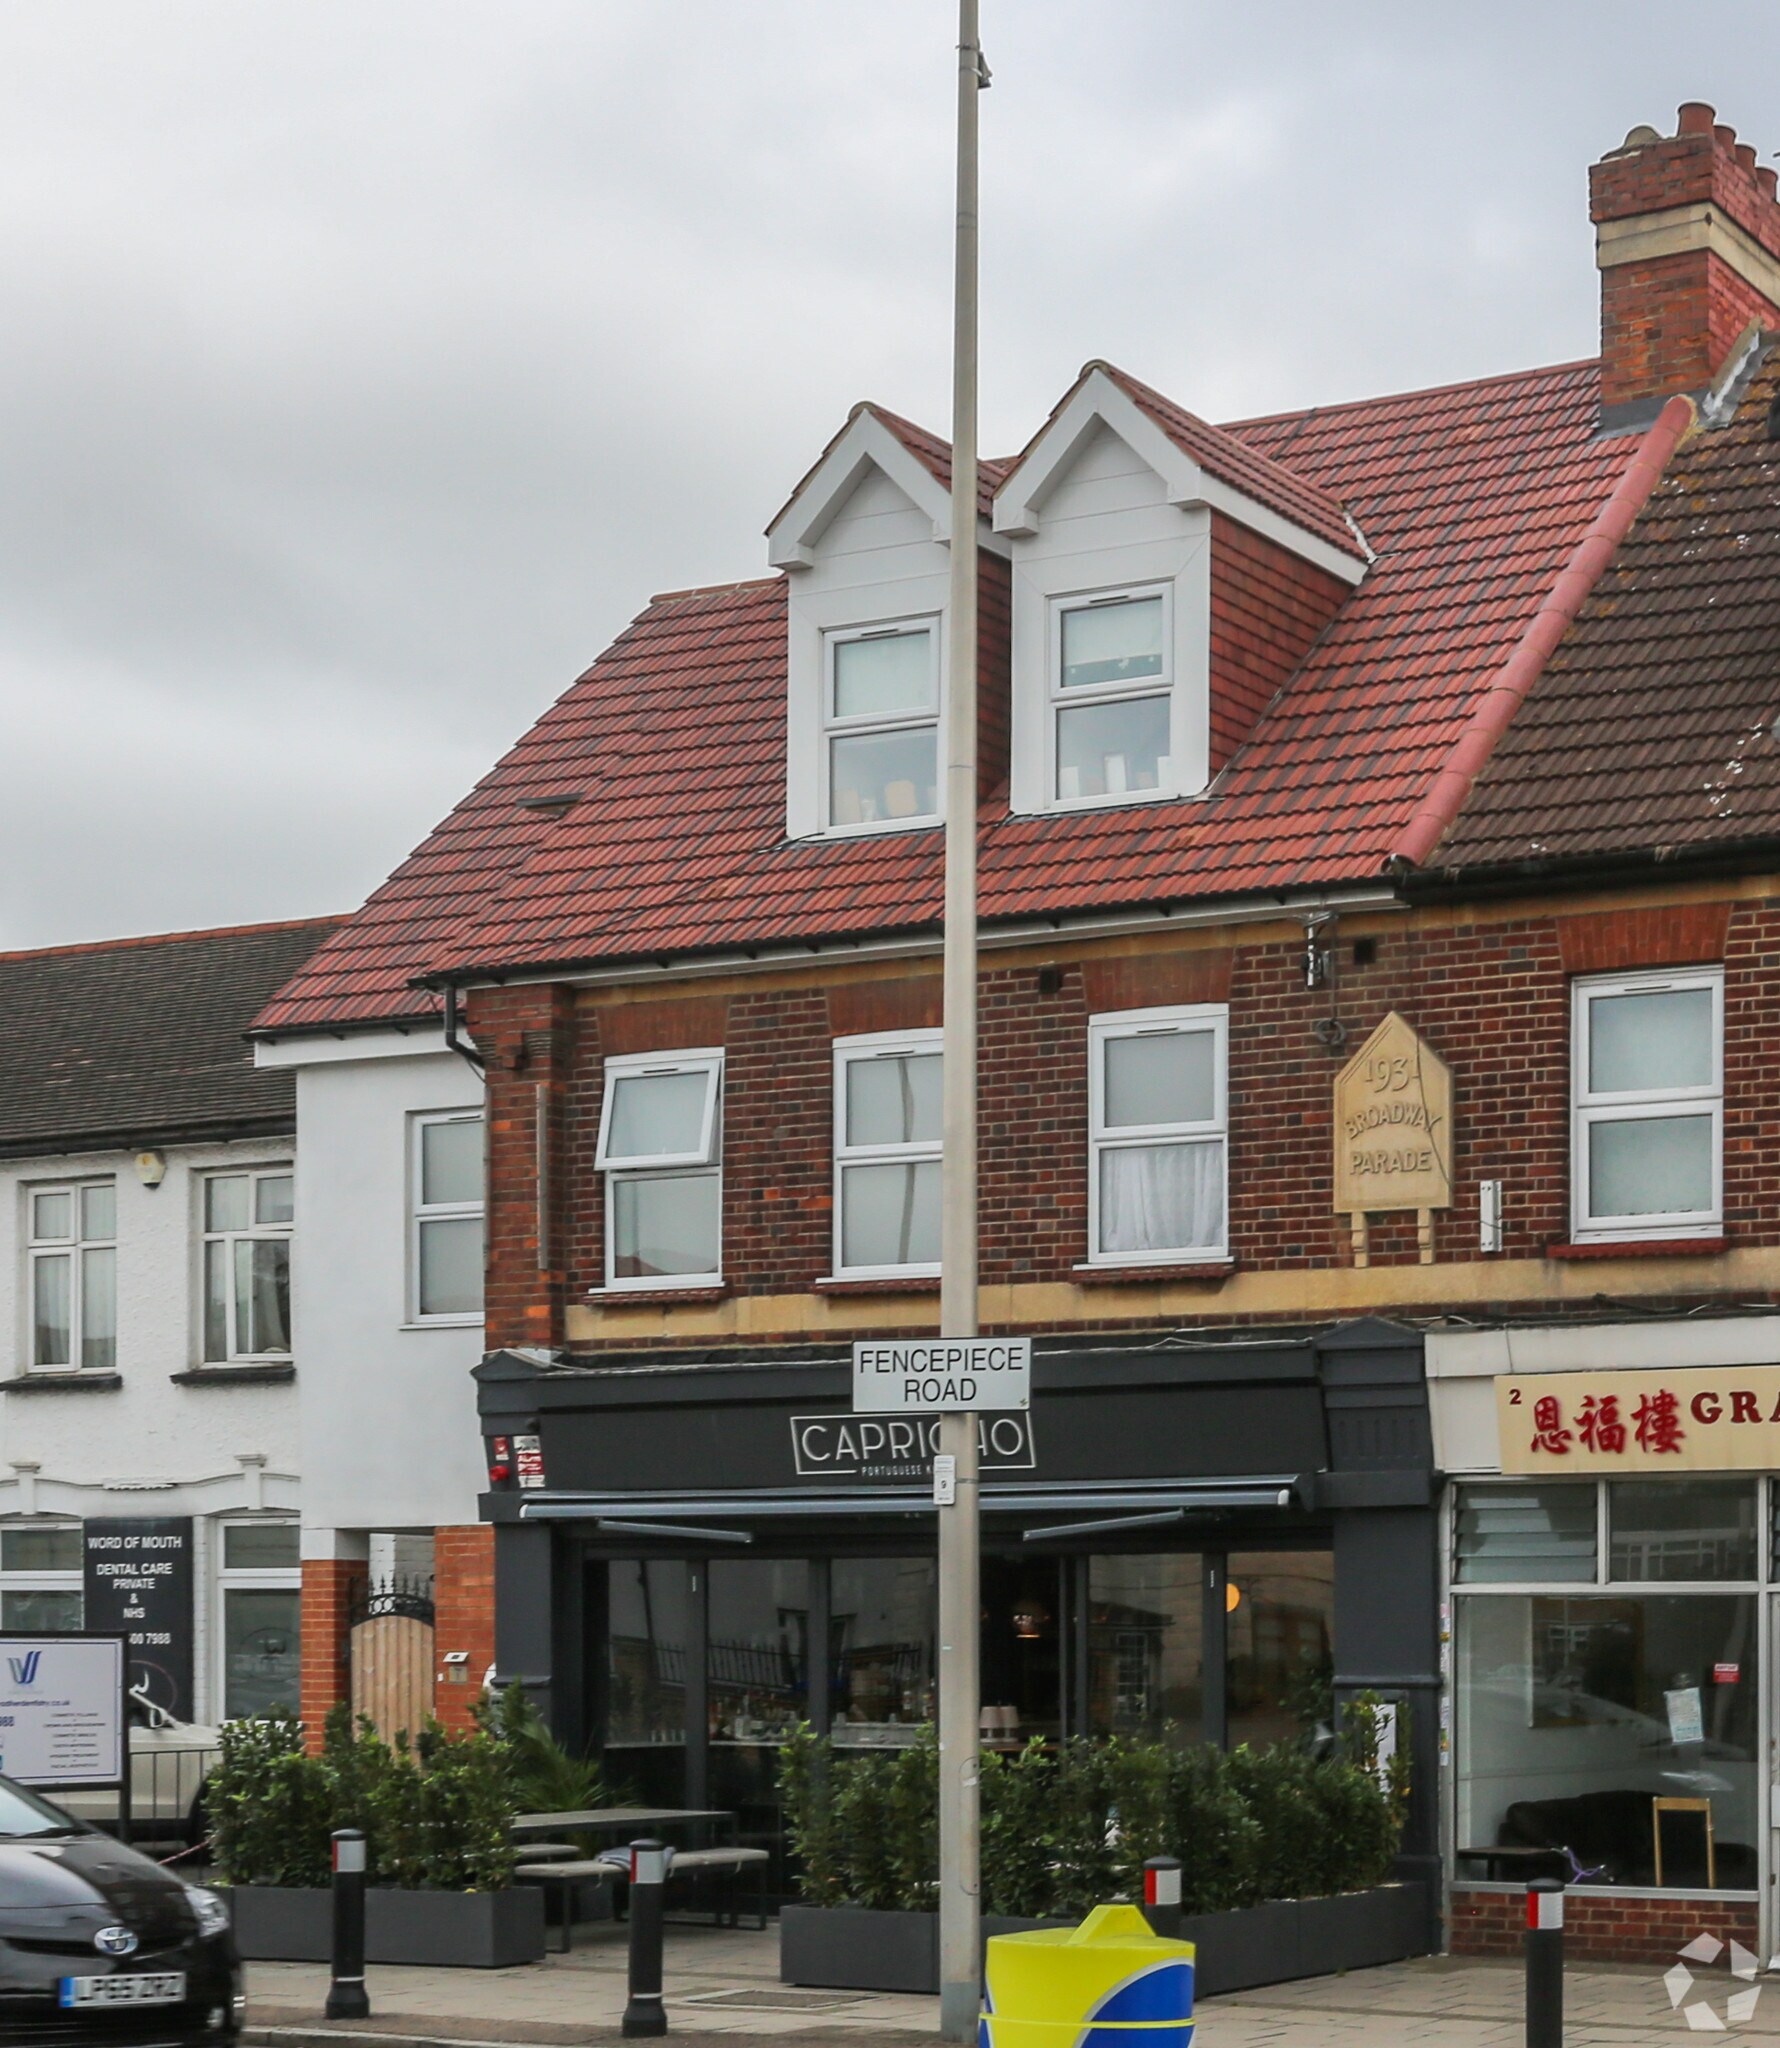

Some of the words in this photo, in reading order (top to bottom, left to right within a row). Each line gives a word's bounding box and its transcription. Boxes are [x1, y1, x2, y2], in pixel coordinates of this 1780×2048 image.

[1345, 1101, 1442, 1140] BROADWAY
[1349, 1149, 1432, 1175] PARADE
[860, 1347, 1023, 1373] FENCEPIECE
[904, 1378, 977, 1403] ROAD
[1509, 1388, 1522, 1405] 2
[861, 1465, 922, 1477] PORTUGUESE
[88, 1537, 122, 1549] WORD
[124, 1537, 140, 1549] OF
[141, 1536, 182, 1549] MOUTH
[96, 1563, 140, 1575] DENTAL
[141, 1562, 173, 1575] CARE
[112, 1578, 156, 1590] PRIVATE
[129, 1592, 139, 1604] &
[123, 1607, 146, 1619] NHS
